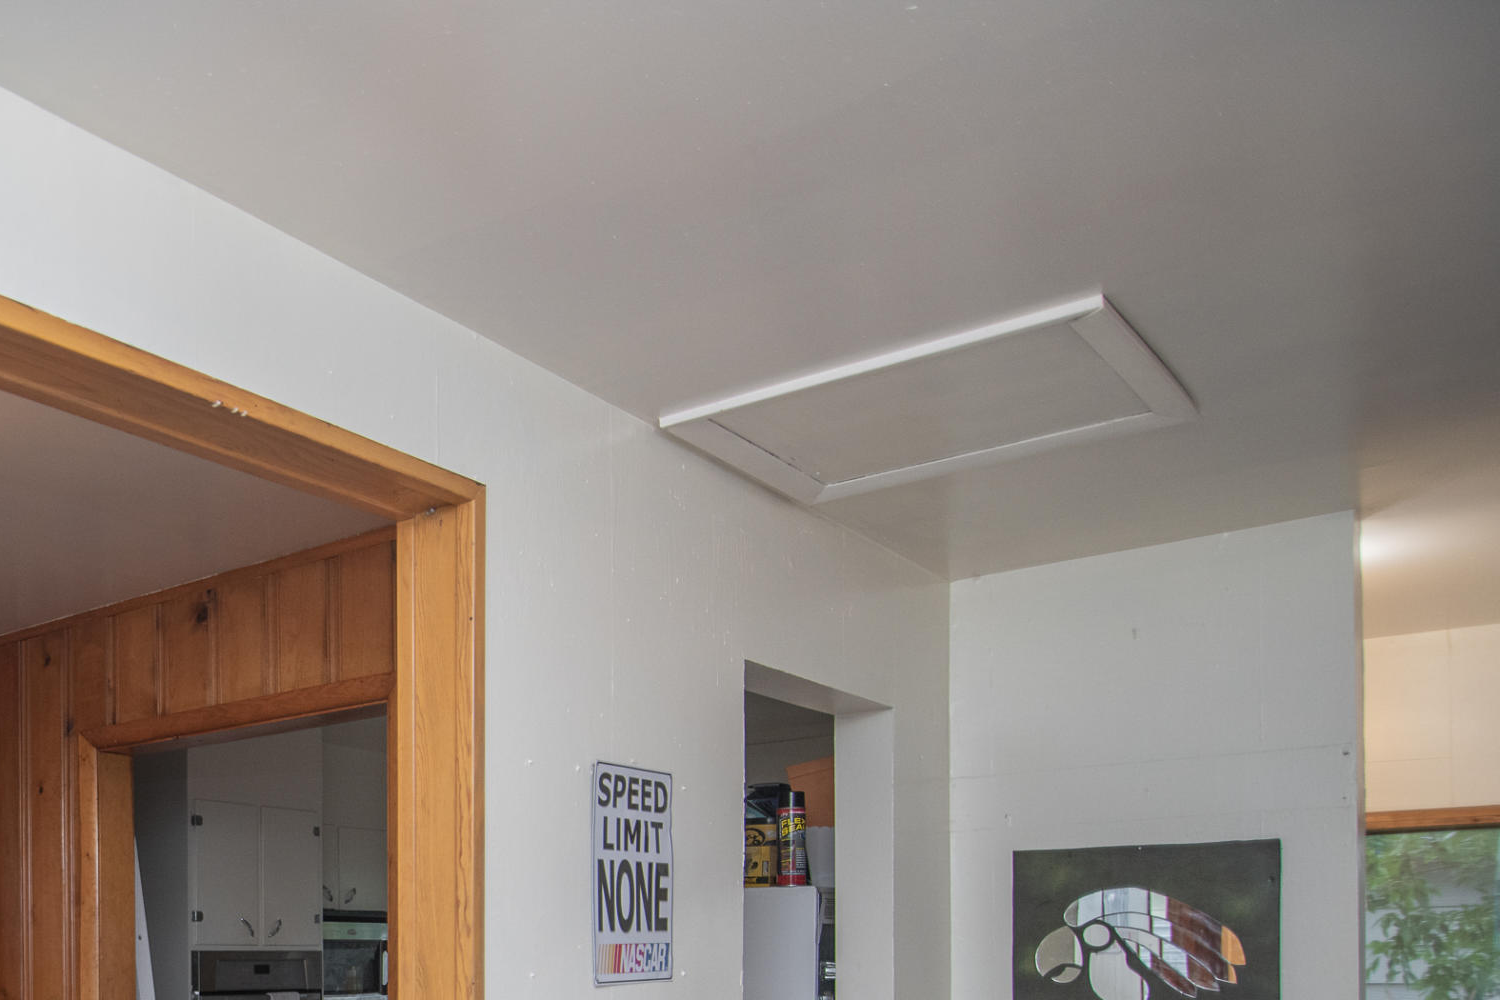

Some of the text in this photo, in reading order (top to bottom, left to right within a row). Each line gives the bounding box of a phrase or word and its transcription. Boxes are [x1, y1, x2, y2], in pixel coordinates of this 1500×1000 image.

[597, 772, 669, 814] SPEED
[602, 816, 663, 854] LIMIT
[597, 858, 669, 933] NONE
[619, 943, 667, 973] NASCAR
